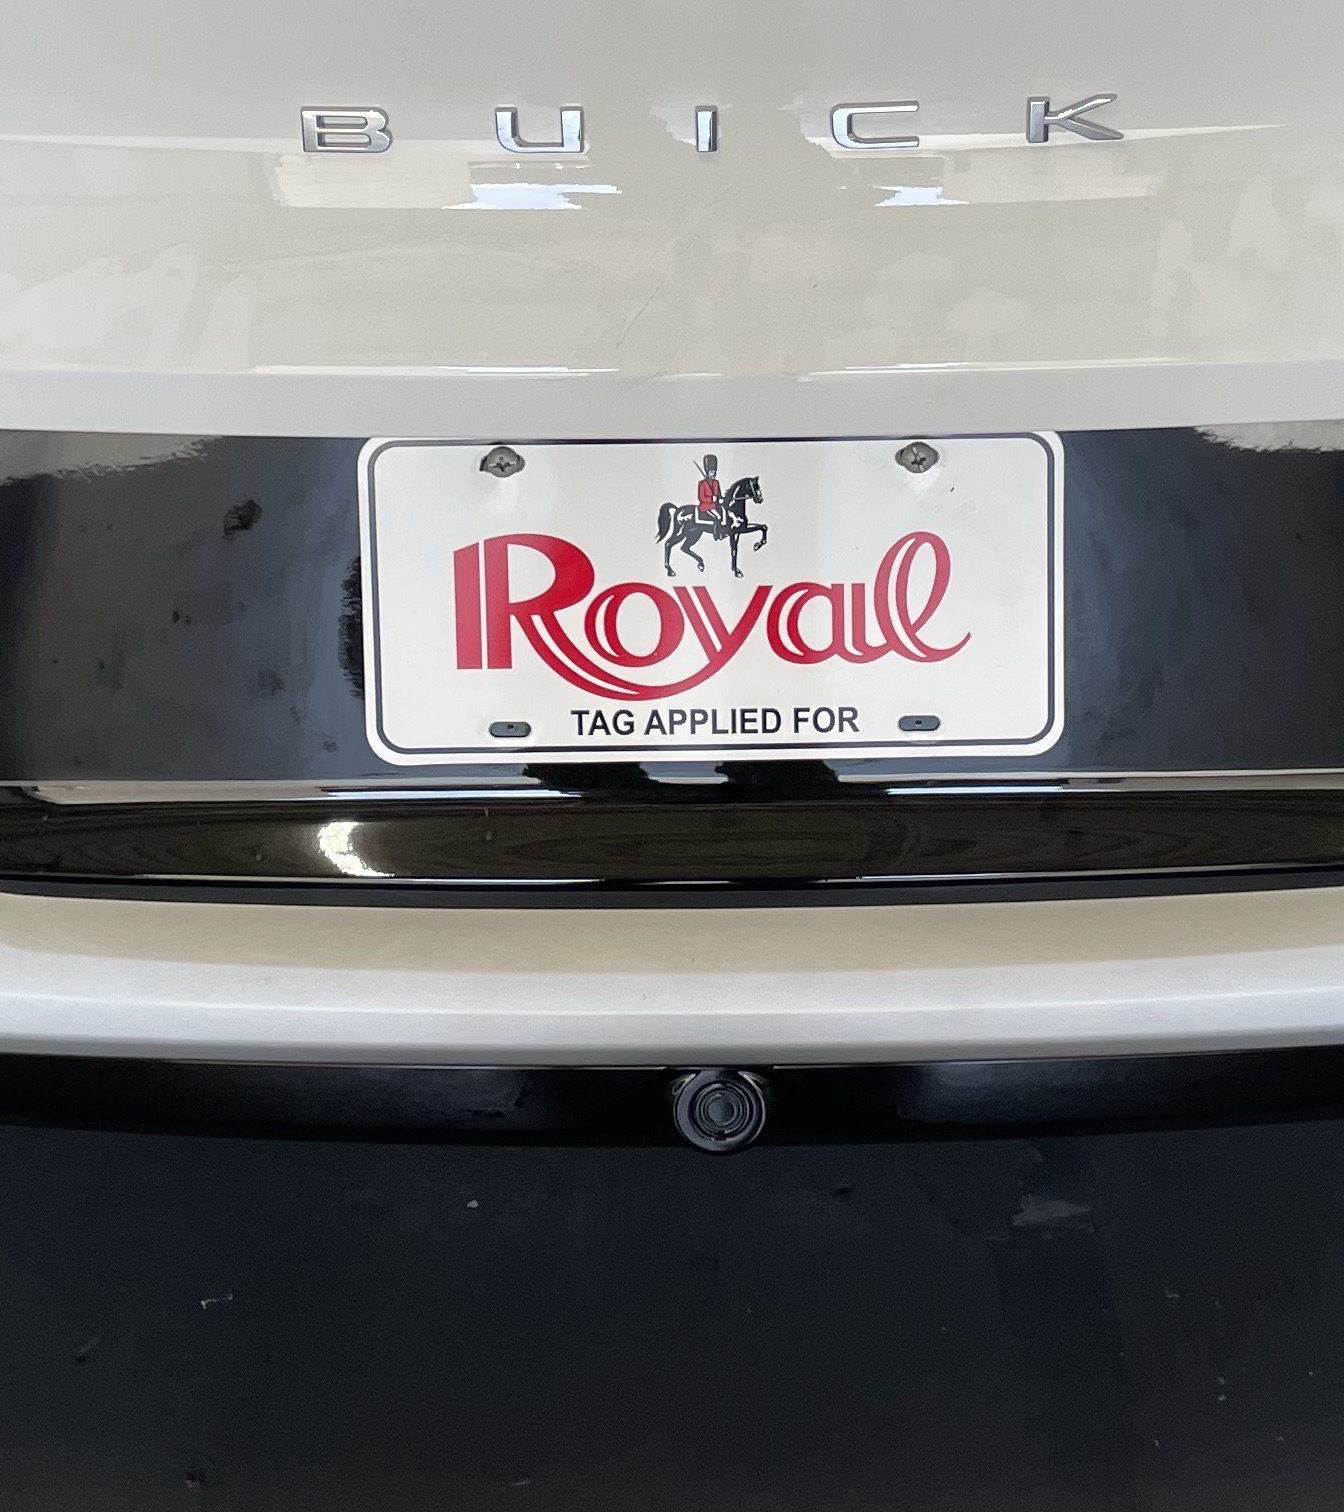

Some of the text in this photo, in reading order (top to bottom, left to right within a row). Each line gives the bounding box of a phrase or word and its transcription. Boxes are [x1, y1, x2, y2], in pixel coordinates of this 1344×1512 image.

[301, 94, 1124, 154] BUICK
[453, 531, 973, 701] Royal
[570, 706, 860, 736] TAG APPLIED FOR
